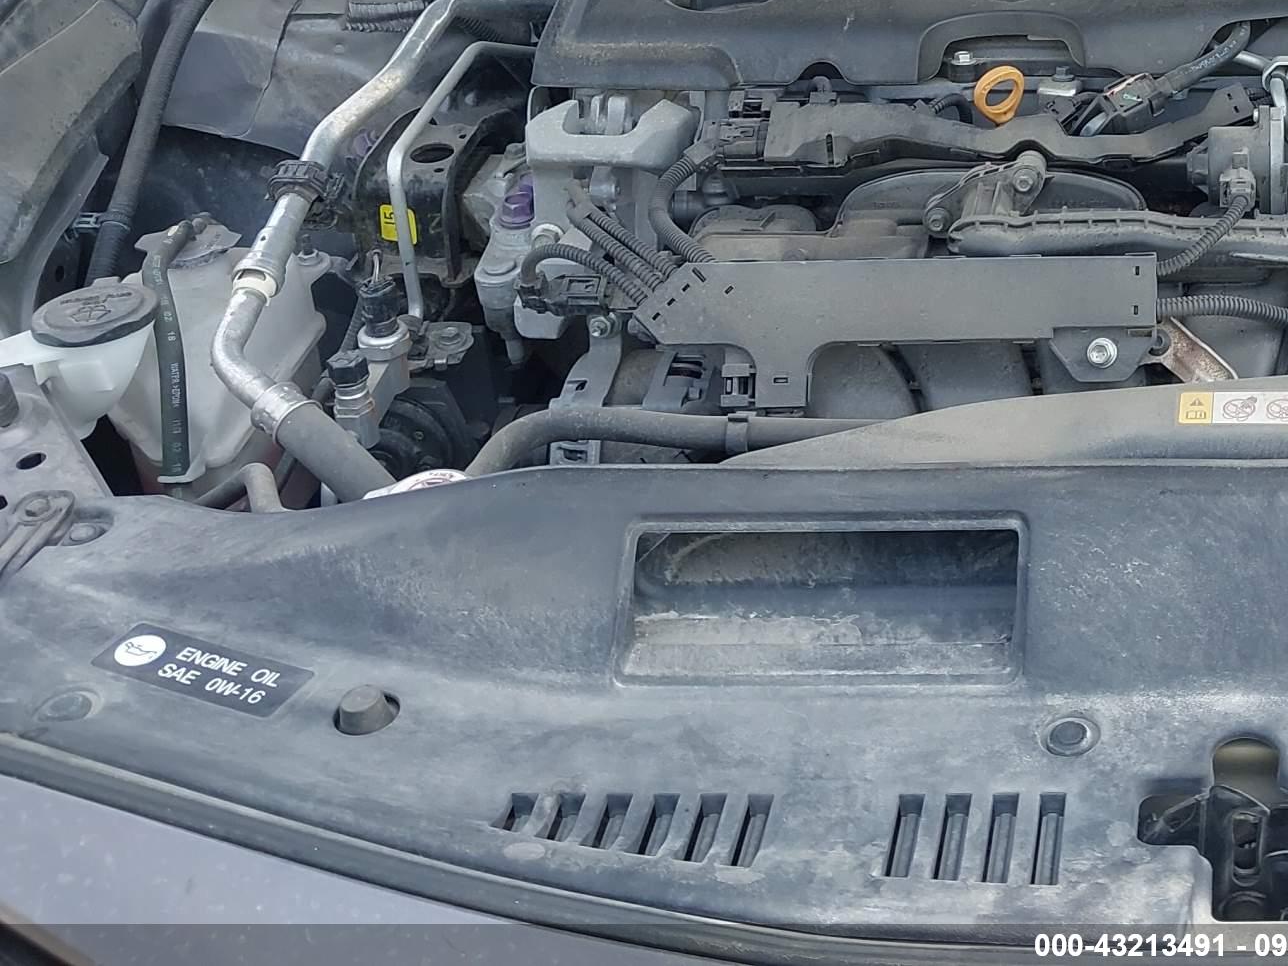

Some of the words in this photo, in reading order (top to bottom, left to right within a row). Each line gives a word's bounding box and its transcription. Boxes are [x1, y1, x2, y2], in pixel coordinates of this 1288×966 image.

[157, 663, 201, 685] SAE
[204, 677, 266, 704] 0W-16
[175, 646, 248, 677] ENGINE
[250, 668, 281, 688] OIL
